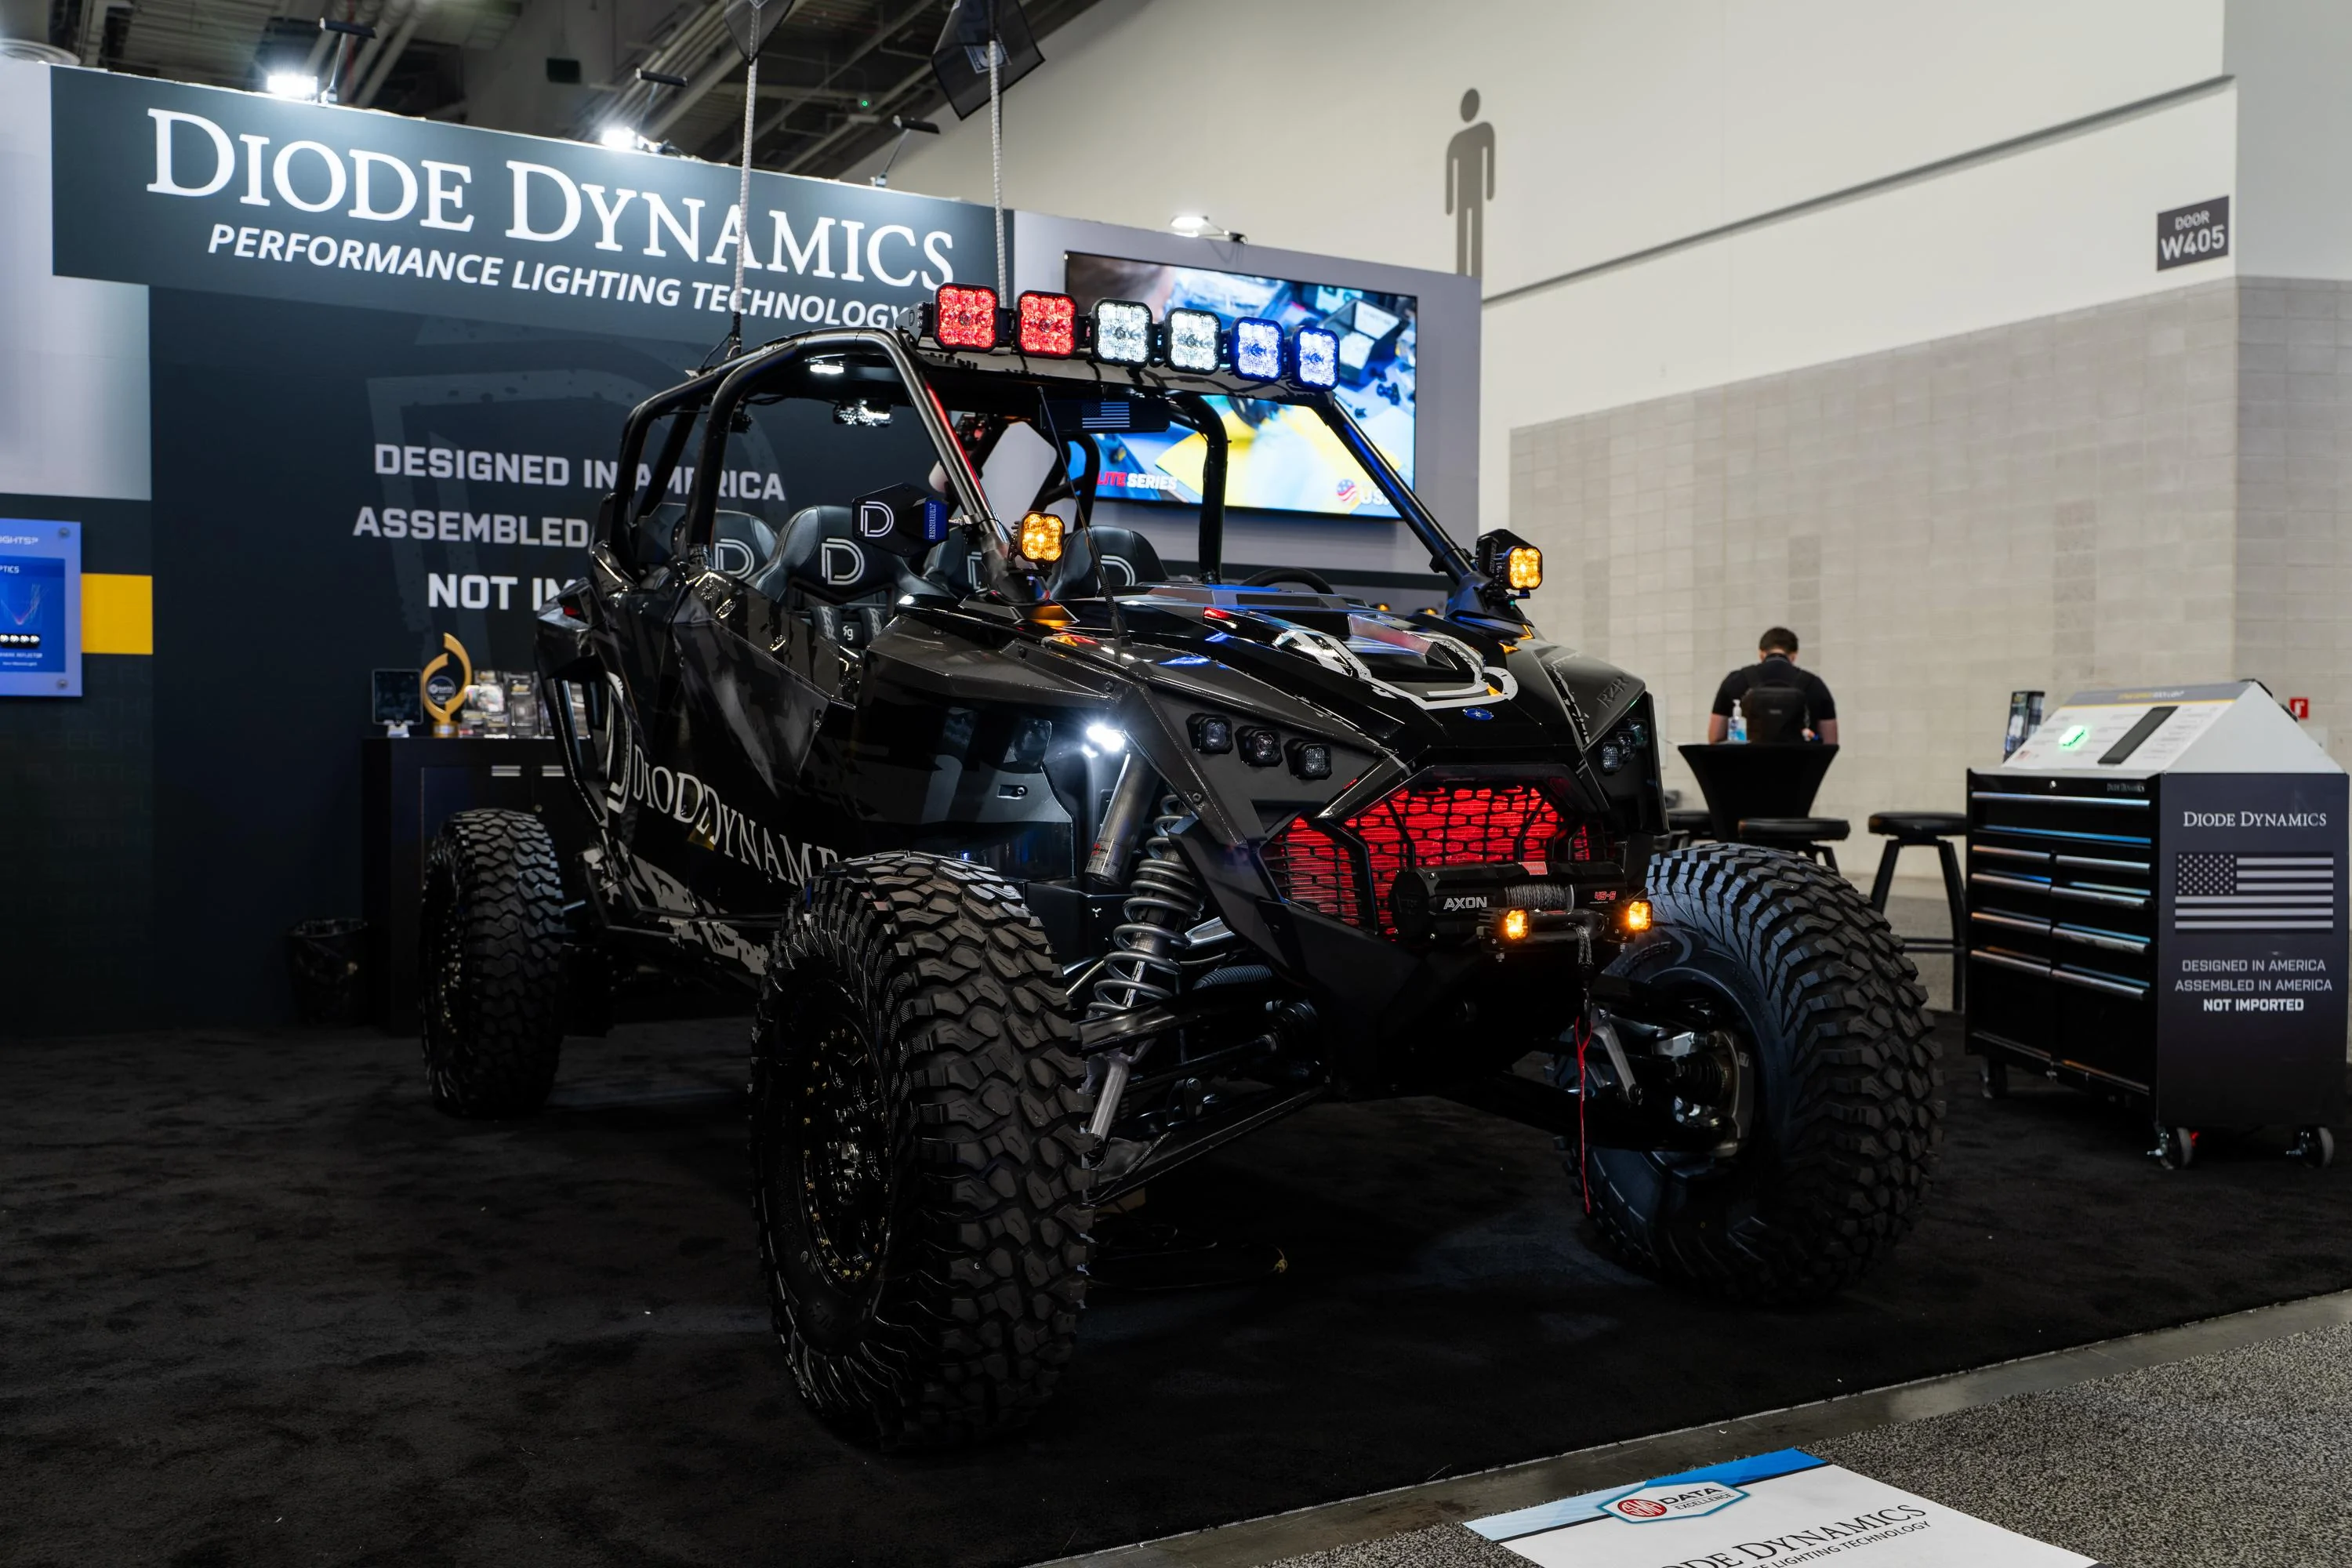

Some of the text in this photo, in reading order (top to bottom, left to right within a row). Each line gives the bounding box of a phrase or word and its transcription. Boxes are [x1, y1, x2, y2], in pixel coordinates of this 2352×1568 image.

[147, 107, 954, 292] DIODE DYNAMICS
[2161, 210, 2225, 261] DOOR W405
[208, 223, 909, 329] PERFORMANCE LIGHTING TECHNOLOGY
[375, 444, 570, 486] DESIGNED
[584, 459, 619, 489] IN
[1097, 471, 1177, 490] LITE SERIES
[1359, 489, 1390, 506] US
[353, 506, 589, 548] ASSEMBLED
[428, 573, 518, 610] NOT
[2183, 811, 2327, 827] DIODE DYNAMICS
[703, 783, 839, 889] DYNAM
[1443, 896, 1488, 911] AXON
[2182, 960, 2326, 972] DESIGNED IN AMERICA
[2175, 979, 2332, 992] ASSEMBLED IN AMERICA
[2203, 998, 2304, 1011] NOT IMPORTED
[1658, 1487, 1722, 1504] DATA
[1675, 1493, 1735, 1510] EXCELLENCE
[1731, 1504, 1926, 1560] DYNAMICS
[1771, 1519, 1931, 1568] LIGHTING TECHNOLOGY
